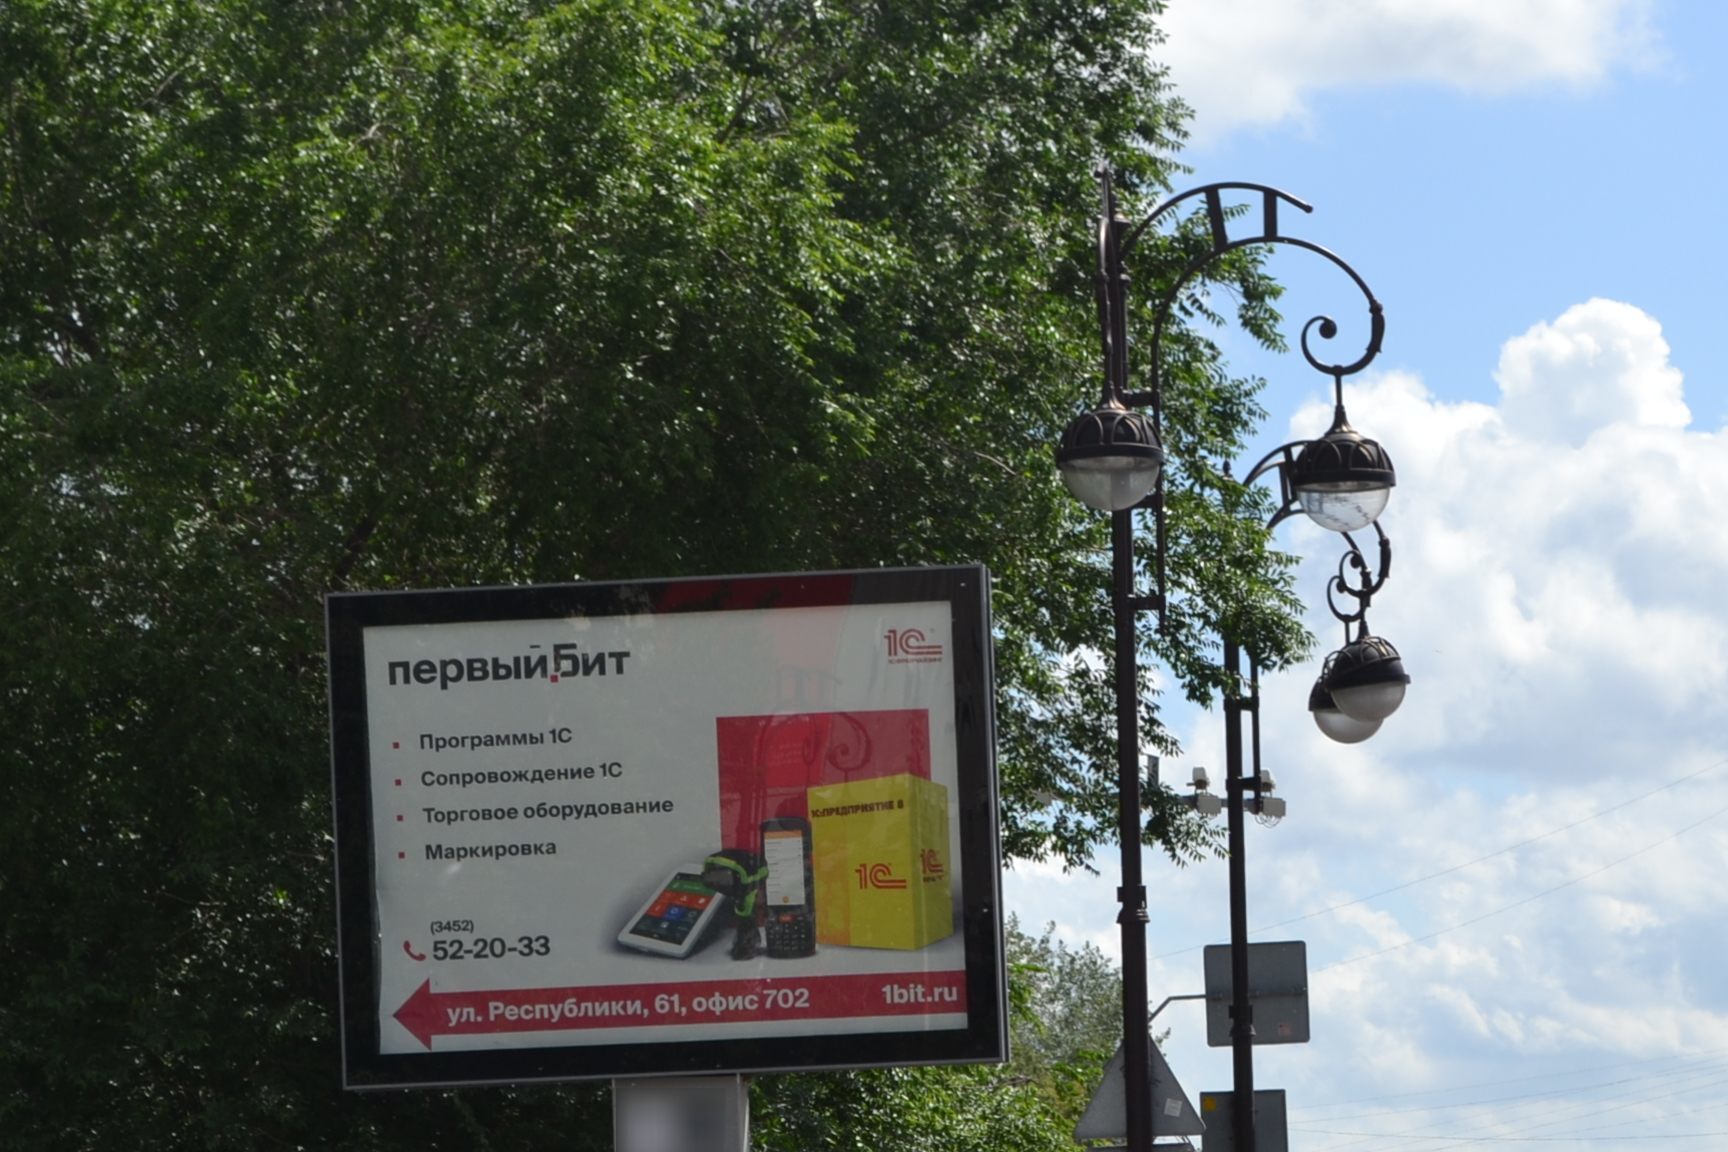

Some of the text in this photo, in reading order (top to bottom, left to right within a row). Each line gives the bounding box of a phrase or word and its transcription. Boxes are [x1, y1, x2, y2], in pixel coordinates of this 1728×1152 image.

[419, 727, 573, 752] Программы 1С
[420, 762, 624, 788] Сопровождение 1С
[422, 799, 675, 826] Торговое оборудование
[424, 841, 557, 862] Маркировка
[855, 863, 907, 889] 1С
[430, 919, 475, 936] (3452)
[432, 935, 551, 961] 52-20-33
[446, 987, 810, 1027] ул. Республики, 61, офис 702
[880, 983, 958, 1005] 1bit.ru
